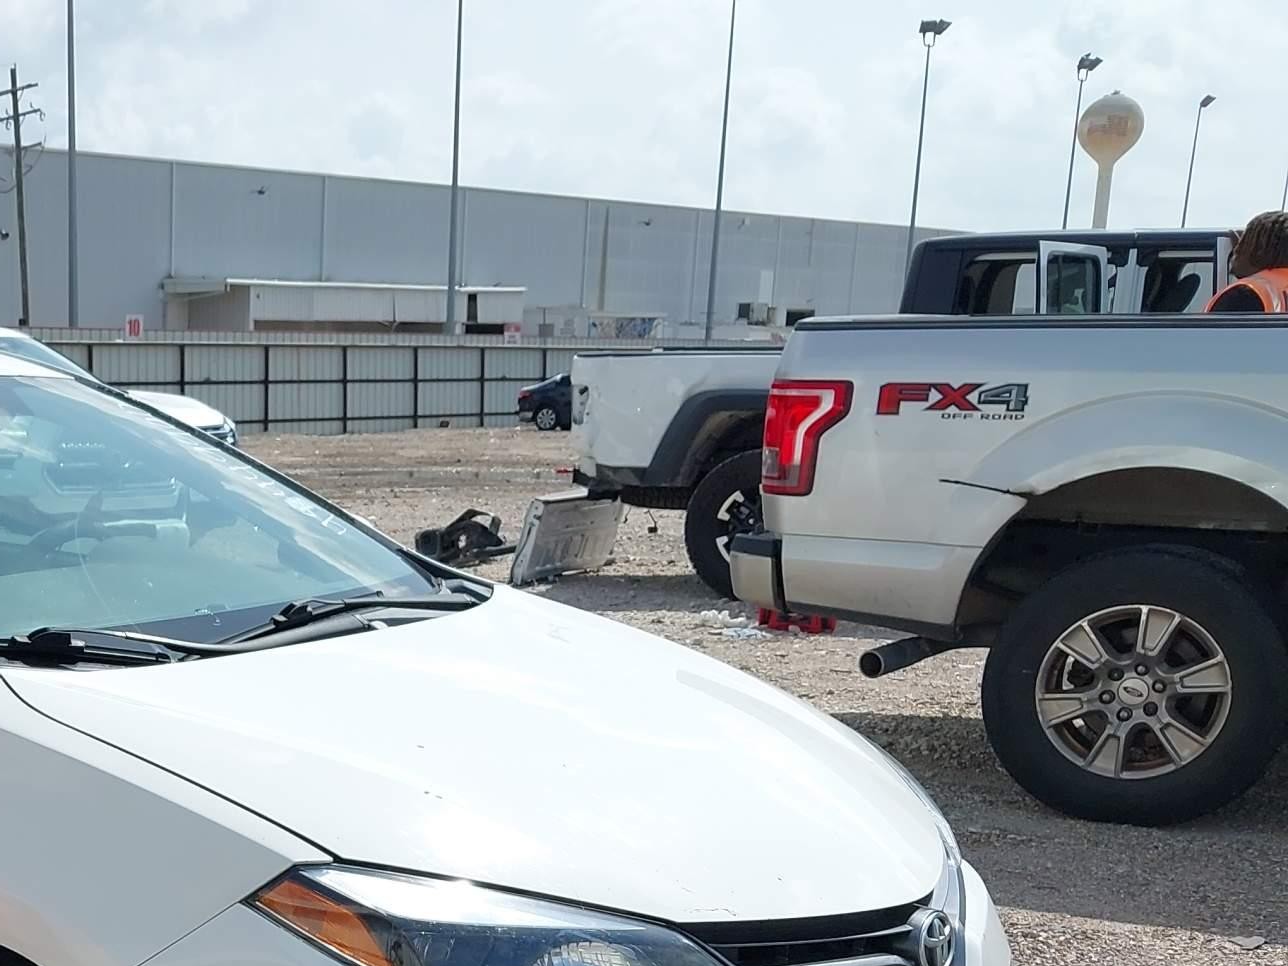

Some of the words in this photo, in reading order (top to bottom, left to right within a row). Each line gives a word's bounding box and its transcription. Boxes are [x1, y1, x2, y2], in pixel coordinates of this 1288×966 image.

[127, 319, 140, 337] 10
[875, 382, 1029, 415] FX4
[941, 412, 974, 421] OFF
[980, 412, 1025, 421] ROAD
